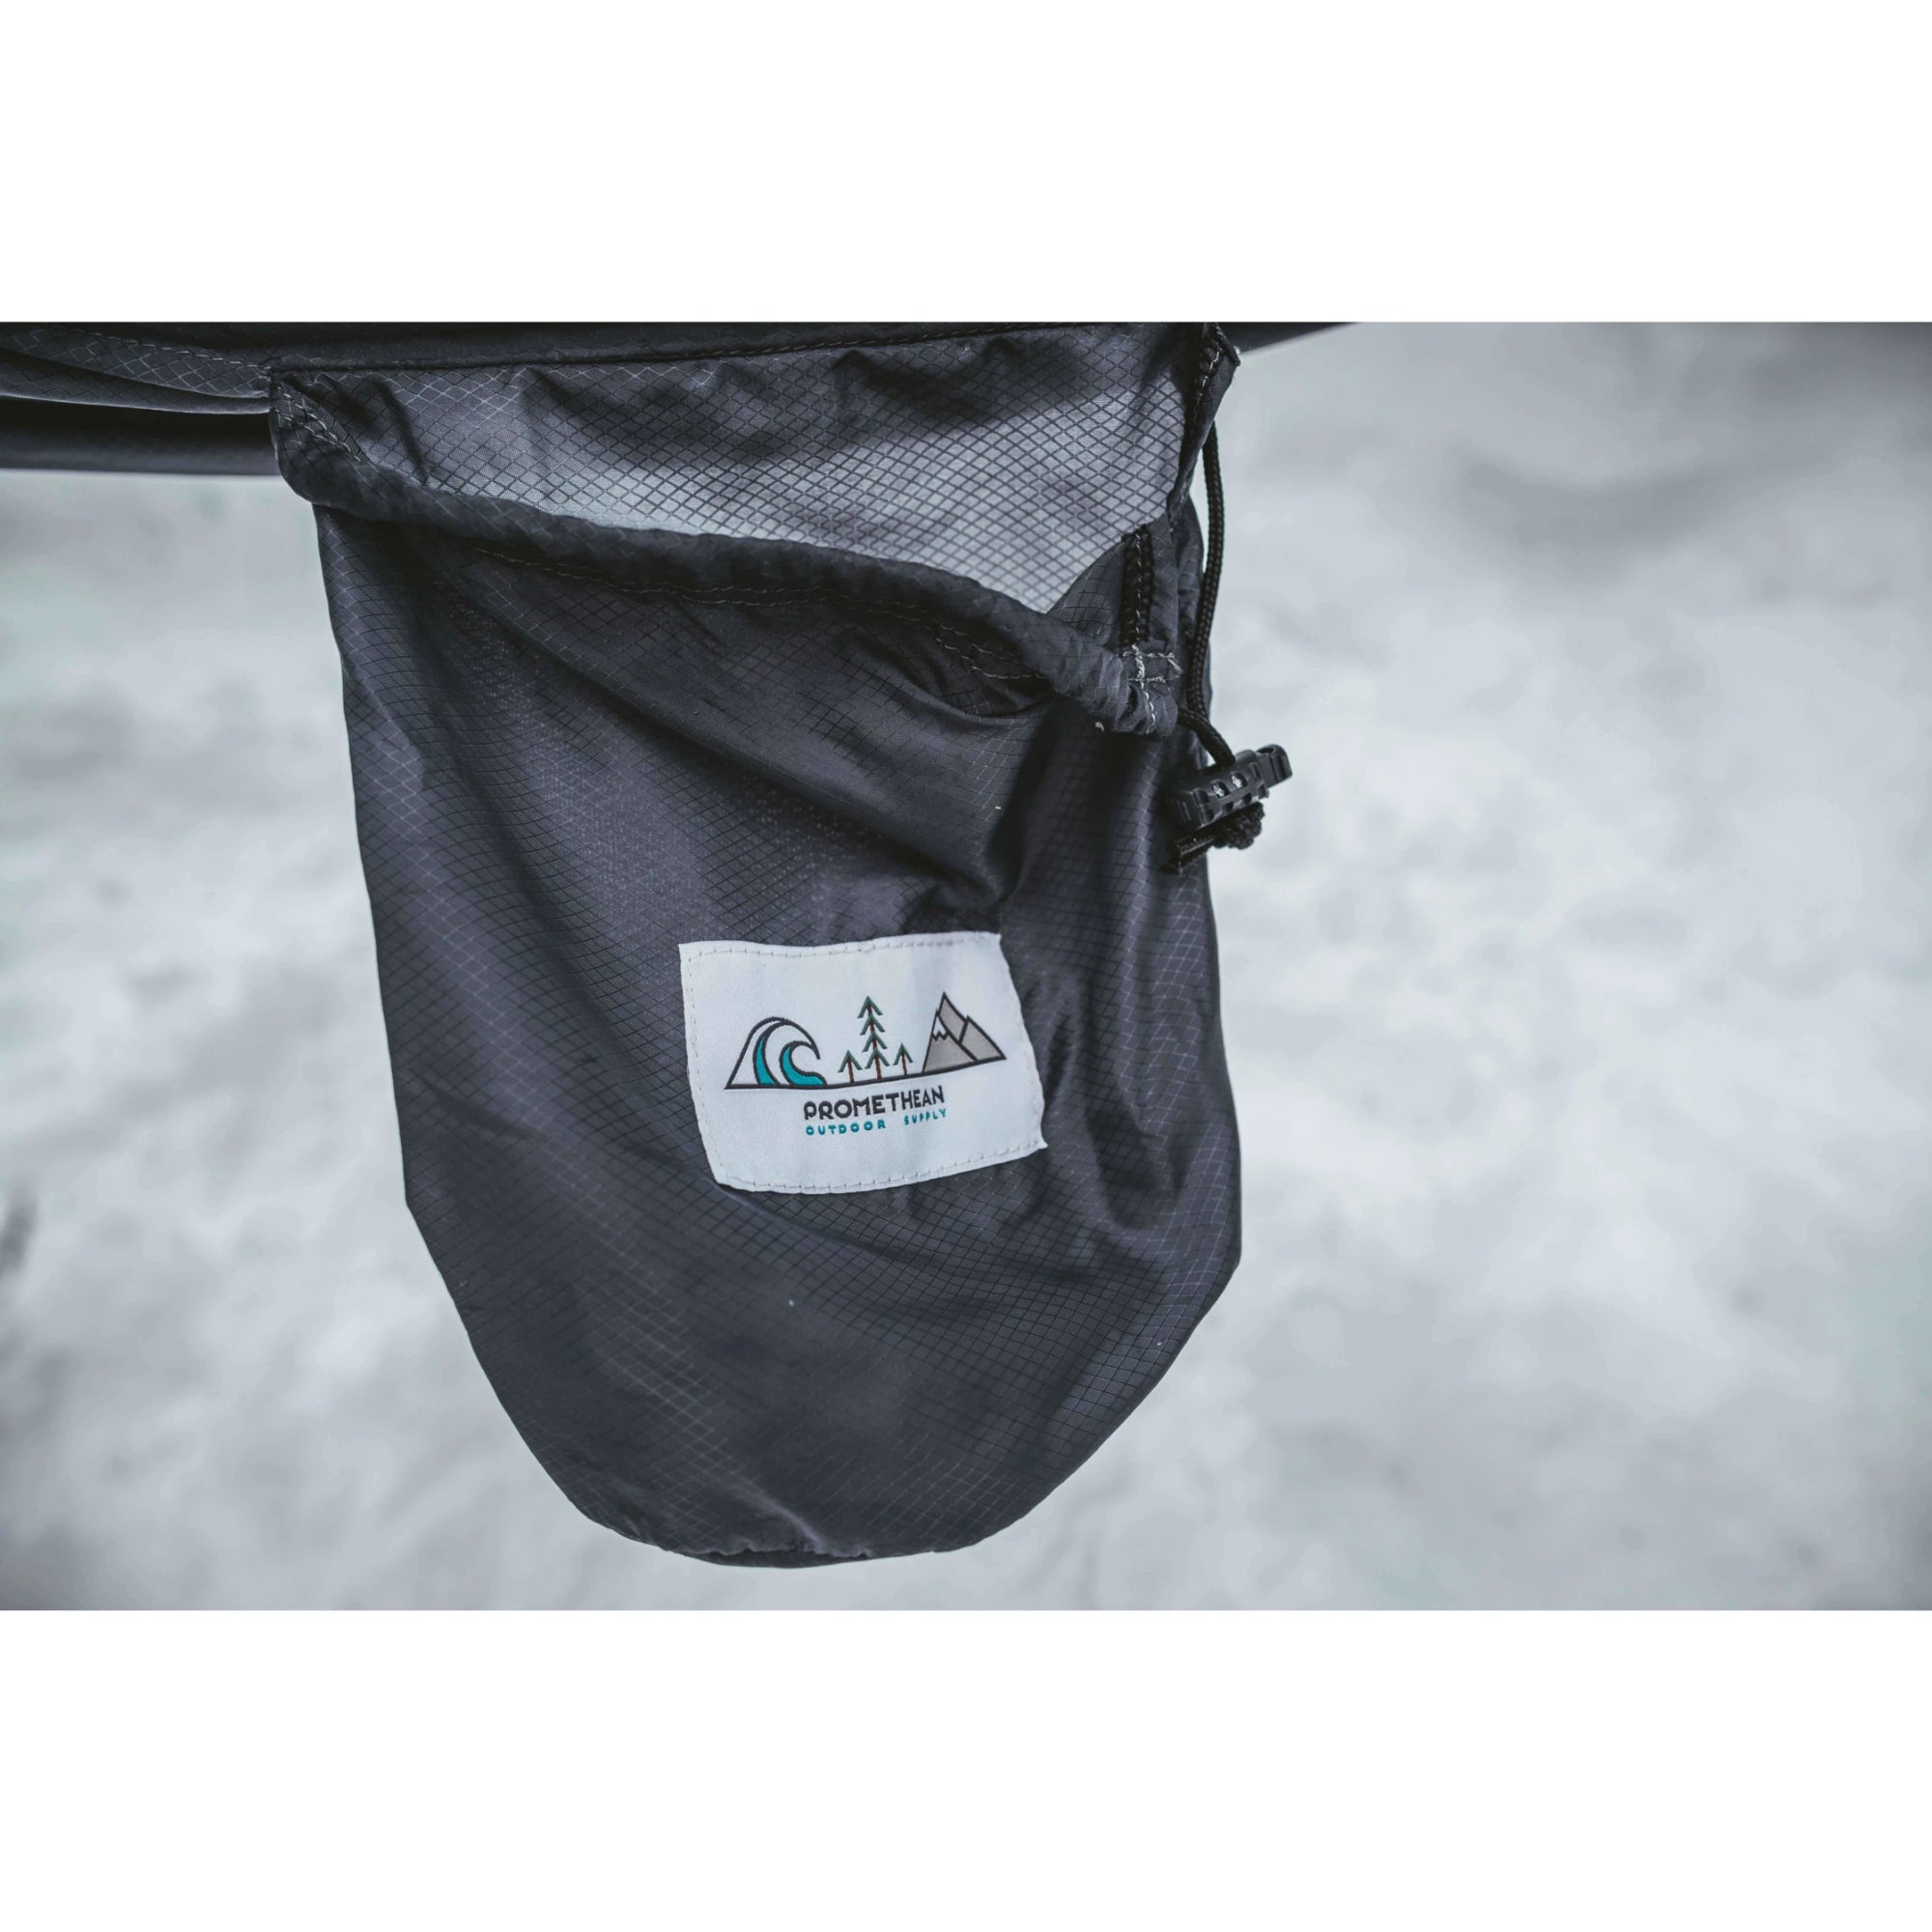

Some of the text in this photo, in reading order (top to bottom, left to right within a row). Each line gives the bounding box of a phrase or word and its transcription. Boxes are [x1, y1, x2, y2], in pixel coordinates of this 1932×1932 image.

[803, 1085, 946, 1121] PROMETHEAN
[805, 1108, 948, 1136] OUTDOOR SUPPLY
